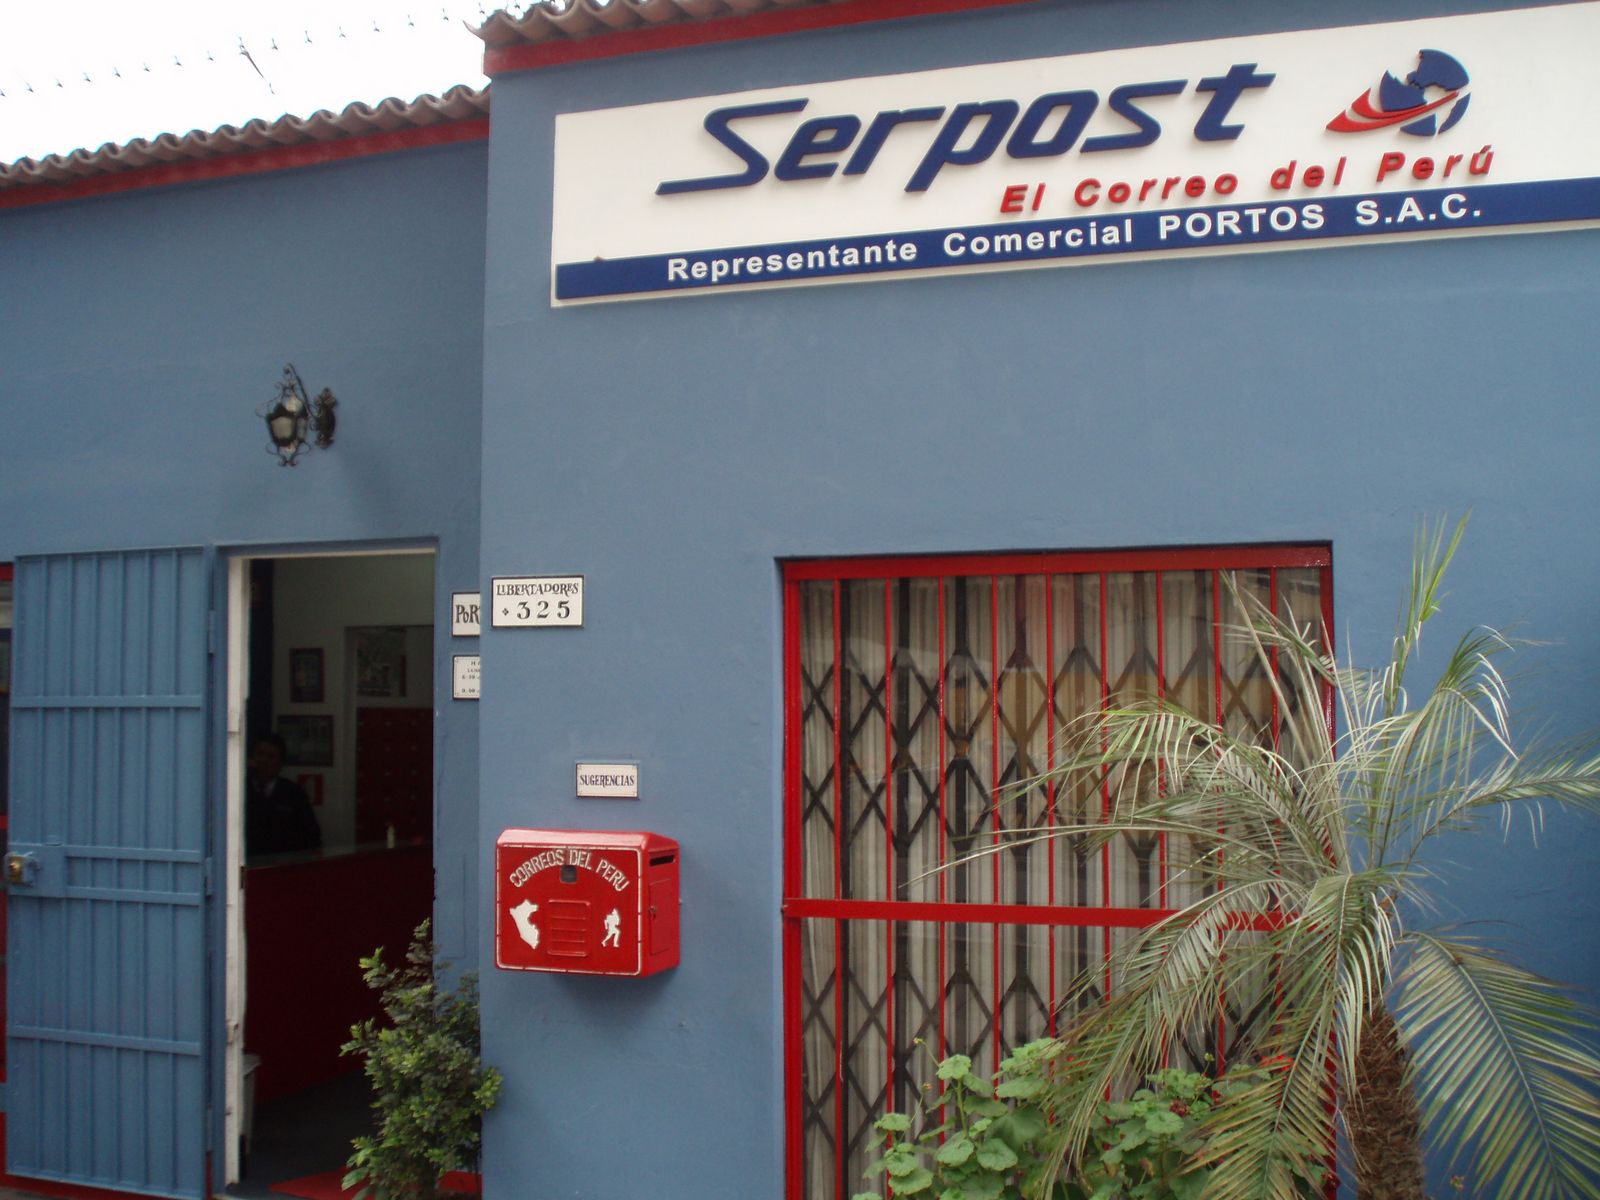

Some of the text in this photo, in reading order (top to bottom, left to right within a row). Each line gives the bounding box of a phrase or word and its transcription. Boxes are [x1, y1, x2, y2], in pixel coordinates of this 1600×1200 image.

[655, 62, 1276, 196] Serpost
[1000, 145, 1495, 214] El Correo del Perú
[667, 193, 1482, 284] Representante Comercial PORTOS S.A.C.
[579, 774, 635, 788] SUGERENCIAS
[509, 849, 630, 892] CORREOS DEL PERU
